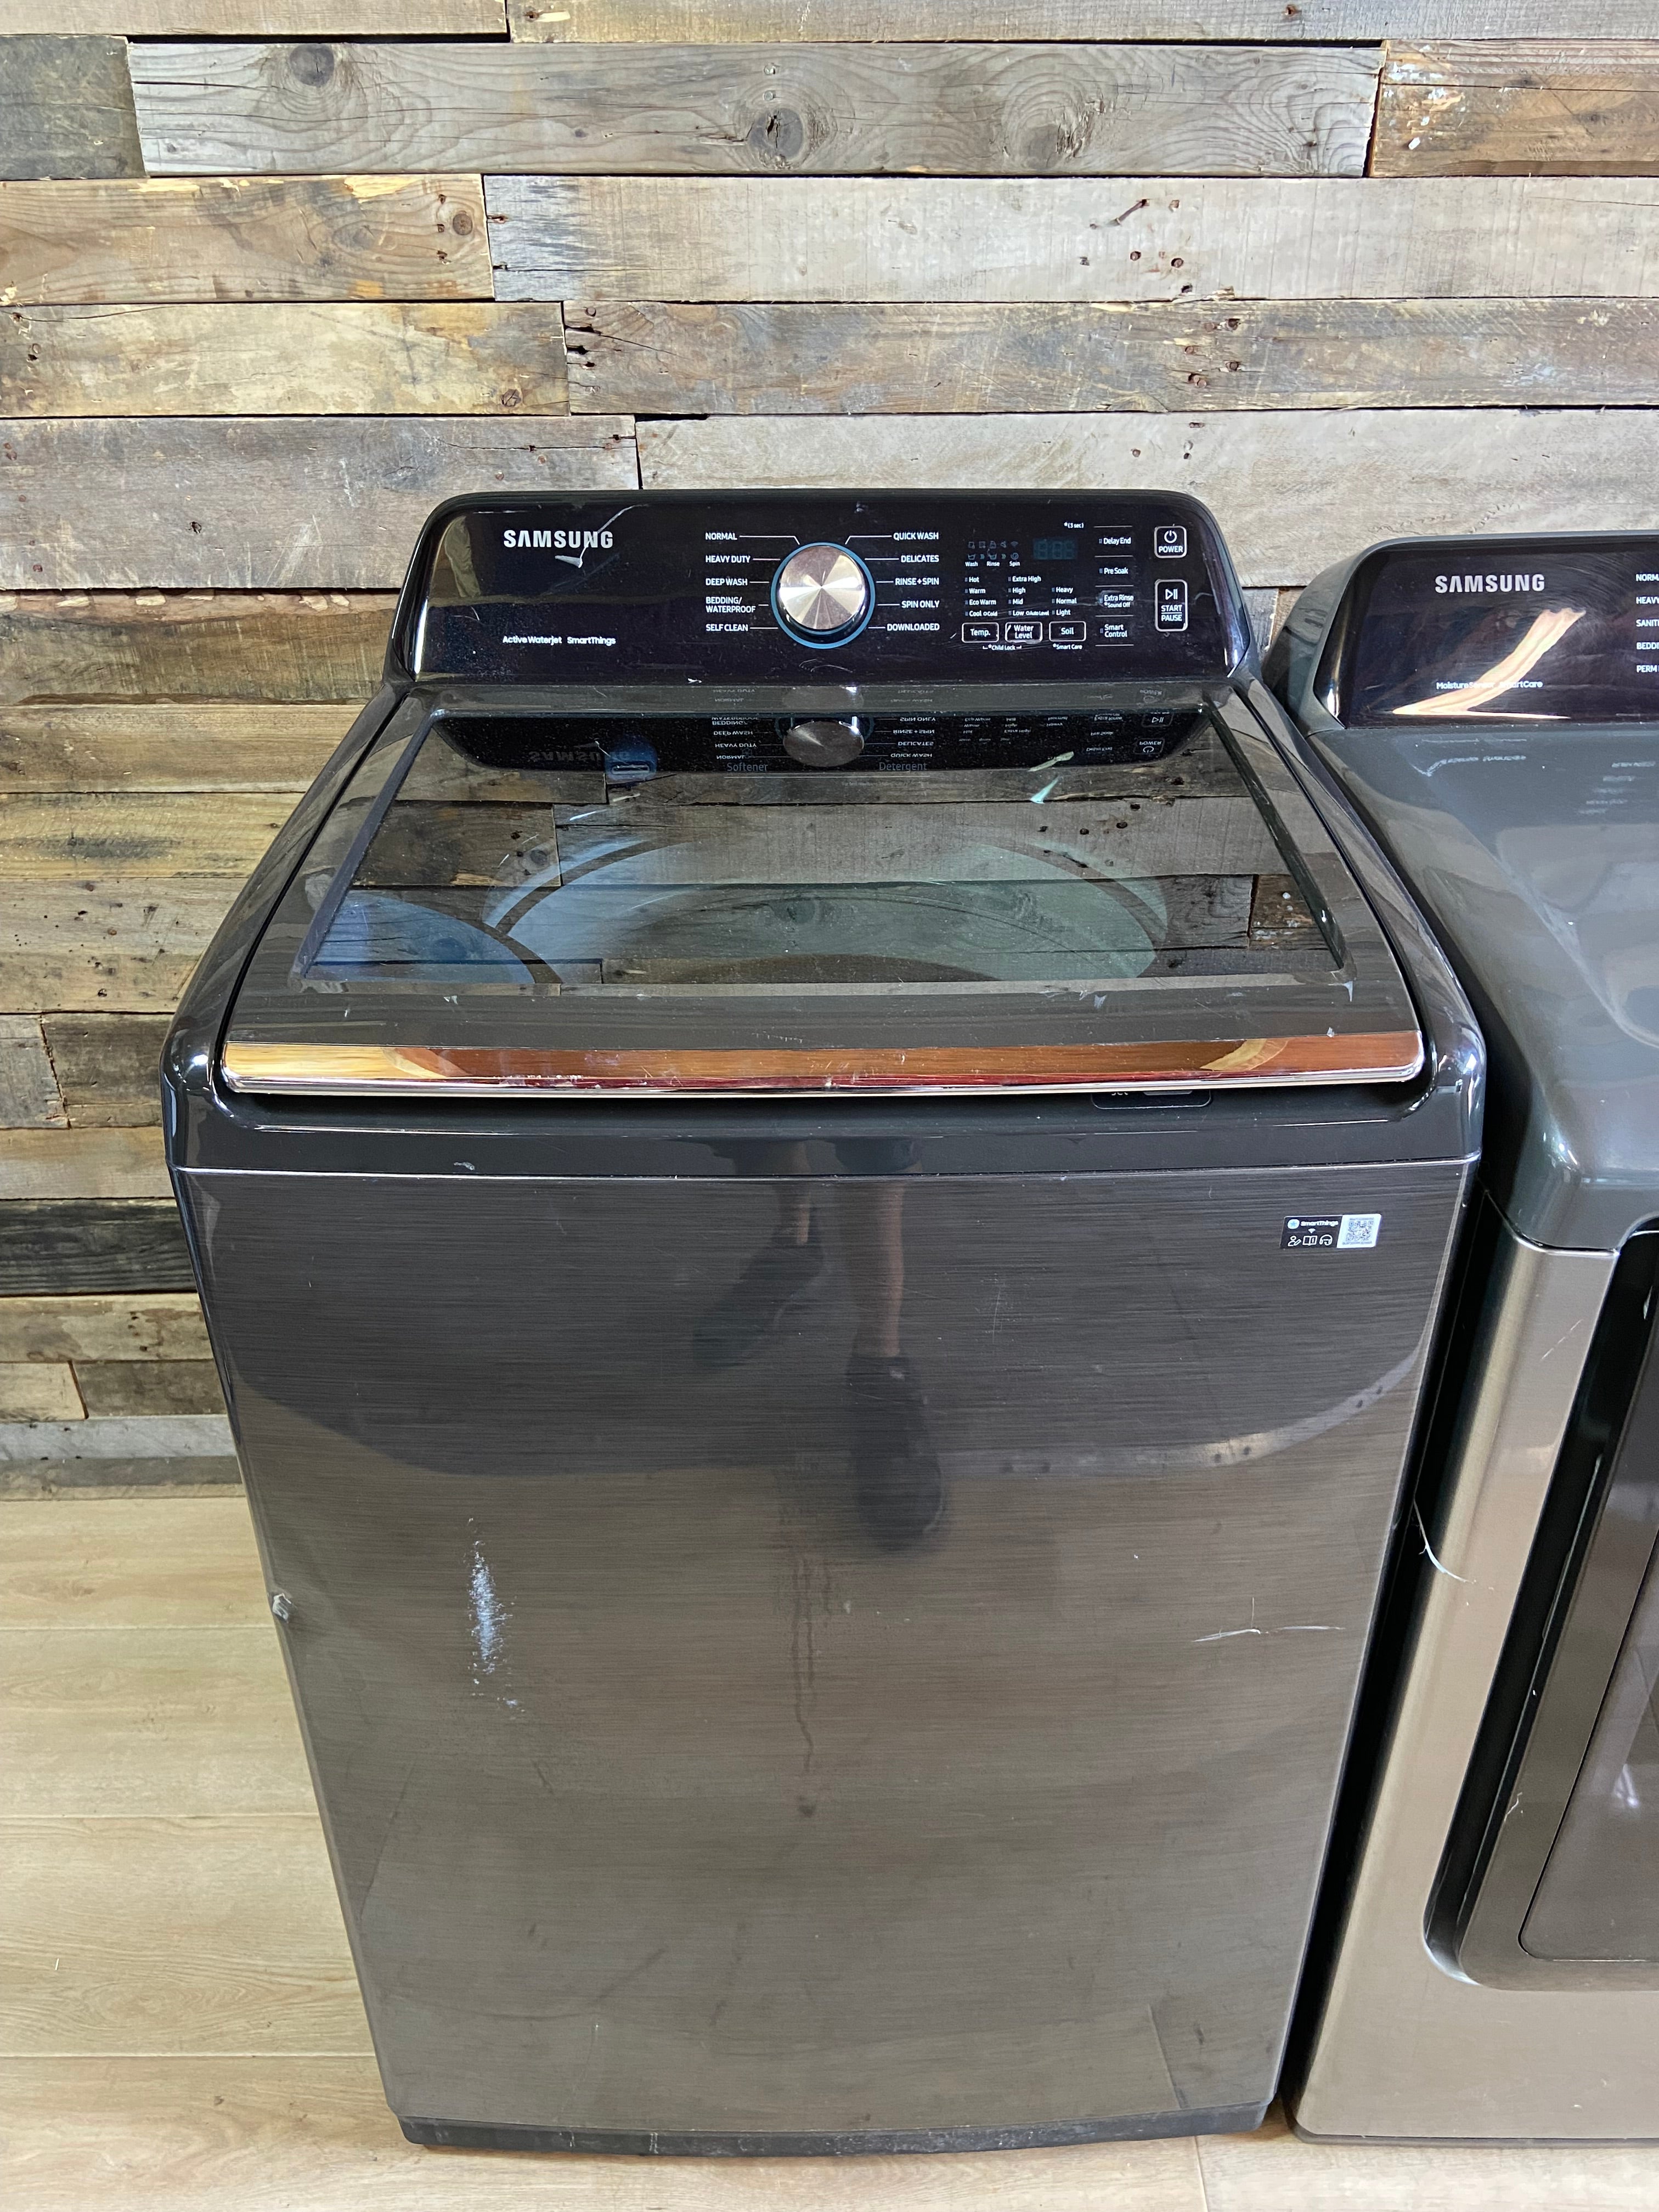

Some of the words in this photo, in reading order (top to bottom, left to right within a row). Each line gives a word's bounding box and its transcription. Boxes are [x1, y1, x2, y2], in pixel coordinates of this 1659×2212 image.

[504, 530, 613, 548] SAMSUNG
[894, 532, 916, 541] QUICK
[1104, 537, 1119, 545] Delay
[1435, 574, 1544, 593] SAMSUNG
[970, 629, 990, 637] Temp.
[727, 763, 768, 771] Softener
[879, 762, 927, 772] Detergent
